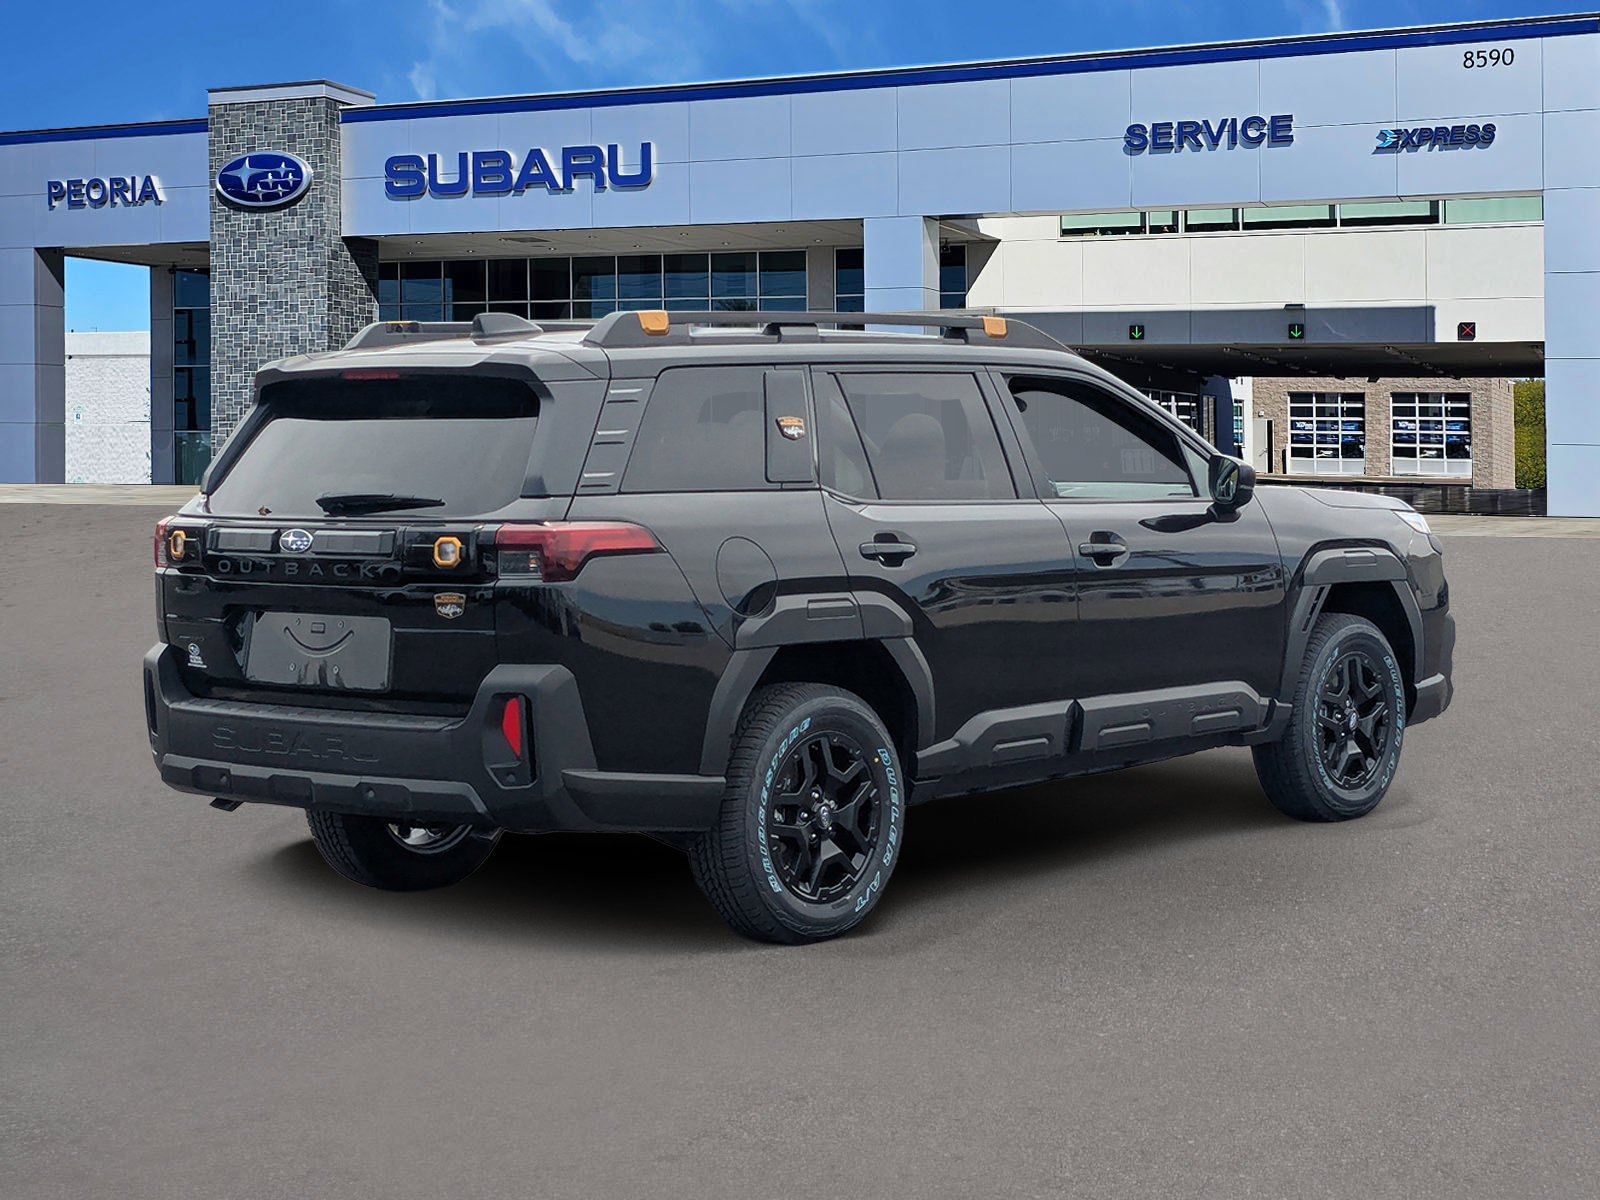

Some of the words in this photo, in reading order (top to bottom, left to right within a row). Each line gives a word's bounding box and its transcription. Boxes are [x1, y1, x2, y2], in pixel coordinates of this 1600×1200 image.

[1463, 48, 1515, 69] 8590
[1124, 114, 1294, 151] SERVICE
[1375, 123, 1497, 149] EXPRESS
[384, 142, 653, 198] SUBARU
[47, 175, 162, 210] PEORIA
[217, 559, 376, 579] OUTBACK
[878, 748, 899, 866] DUELER
